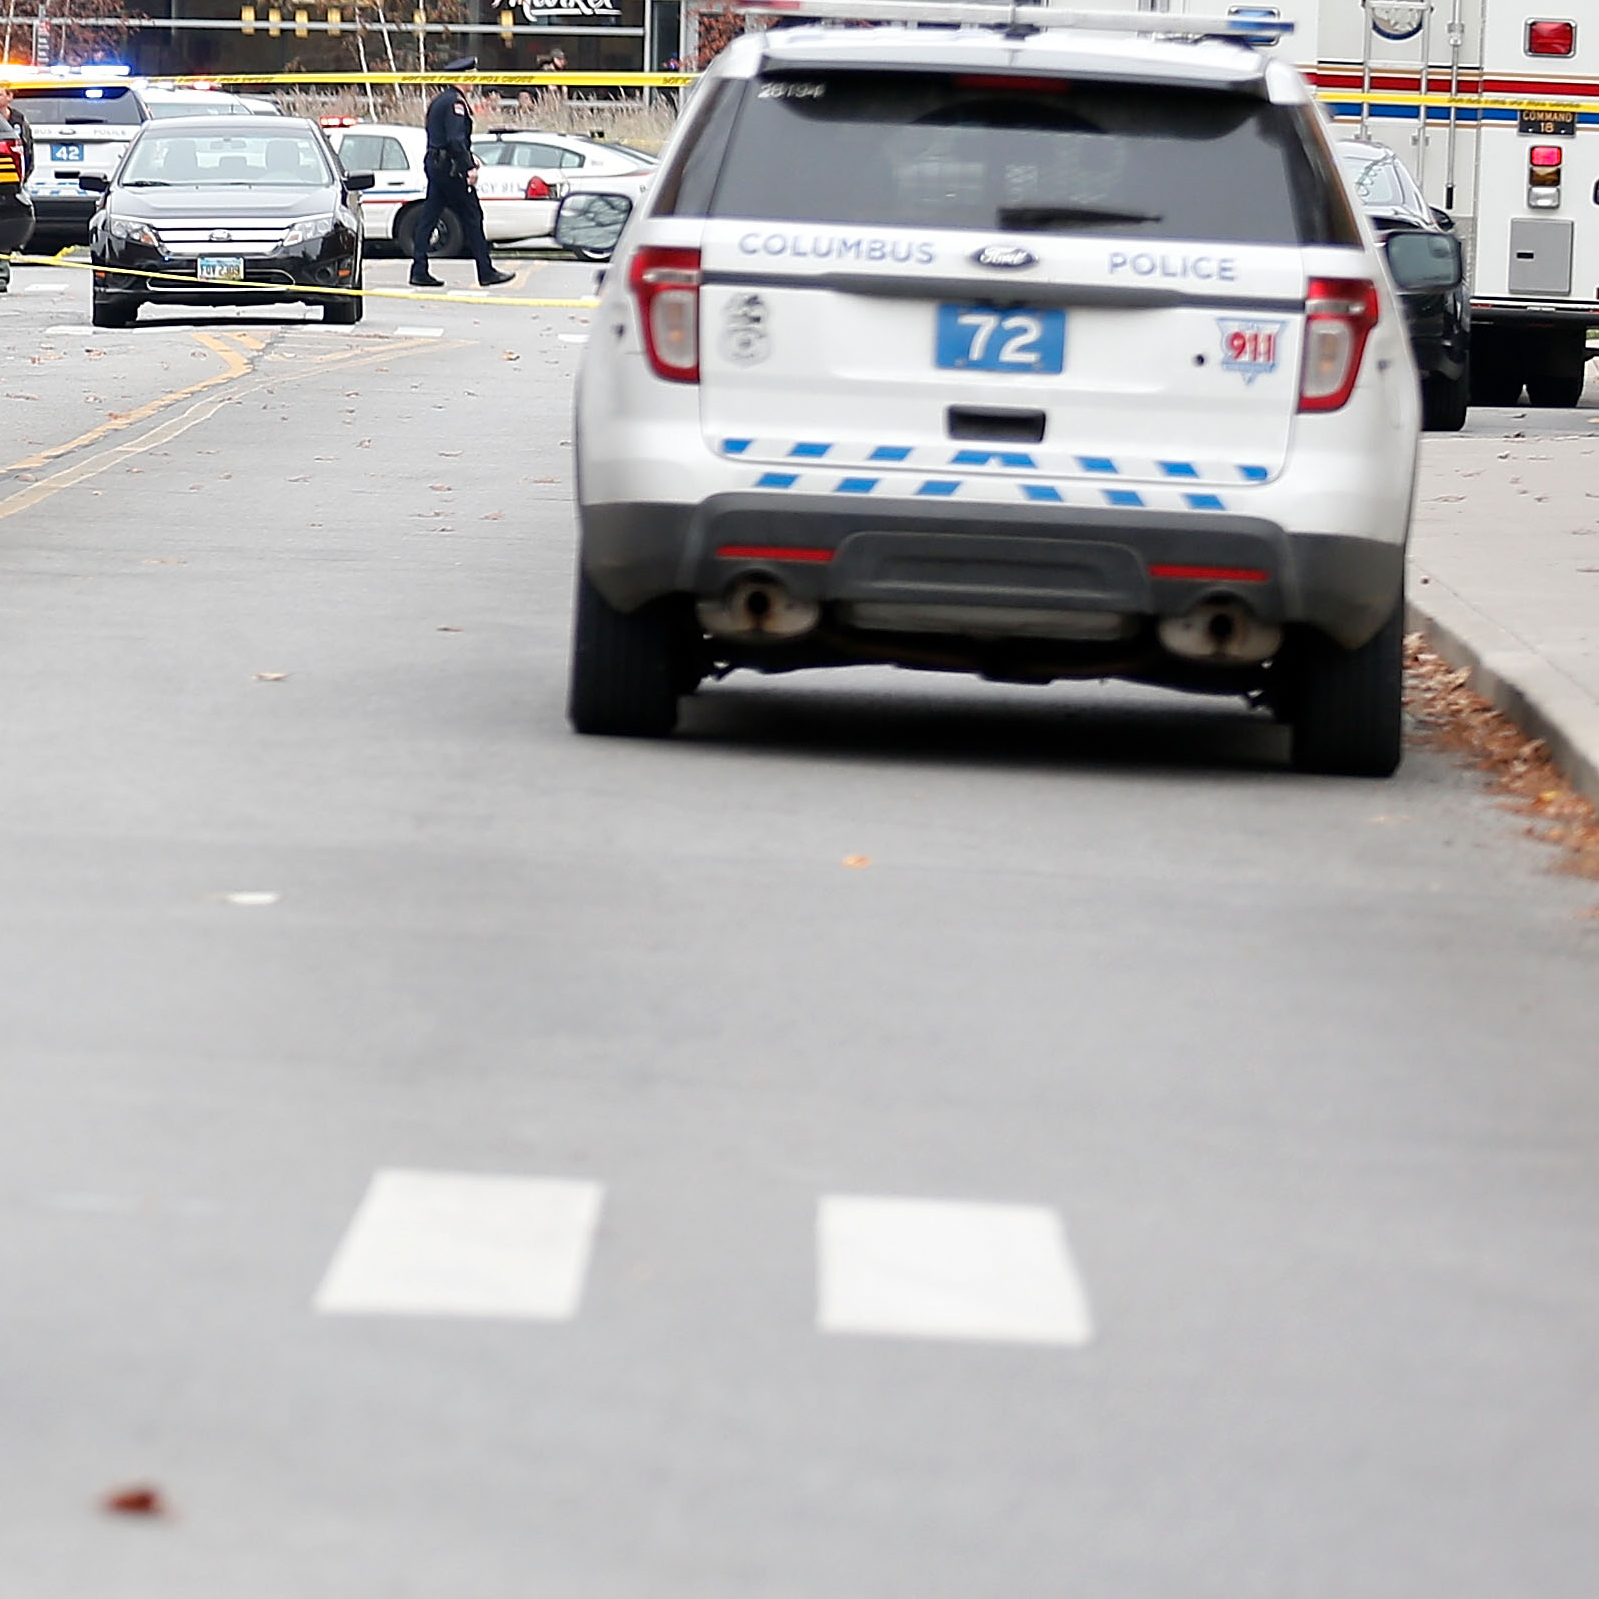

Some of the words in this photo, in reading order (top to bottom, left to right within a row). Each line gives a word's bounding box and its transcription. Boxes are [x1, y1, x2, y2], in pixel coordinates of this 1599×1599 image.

[1522, 109, 1573, 122] COMMAND
[1539, 122, 1554, 133] 18
[55, 145, 80, 161] 42
[738, 232, 935, 265] COLUMBUS
[979, 247, 1032, 266] Ford
[1108, 250, 1238, 282] POLICE
[957, 313, 1043, 364] 72
[1228, 330, 1276, 362] 911
